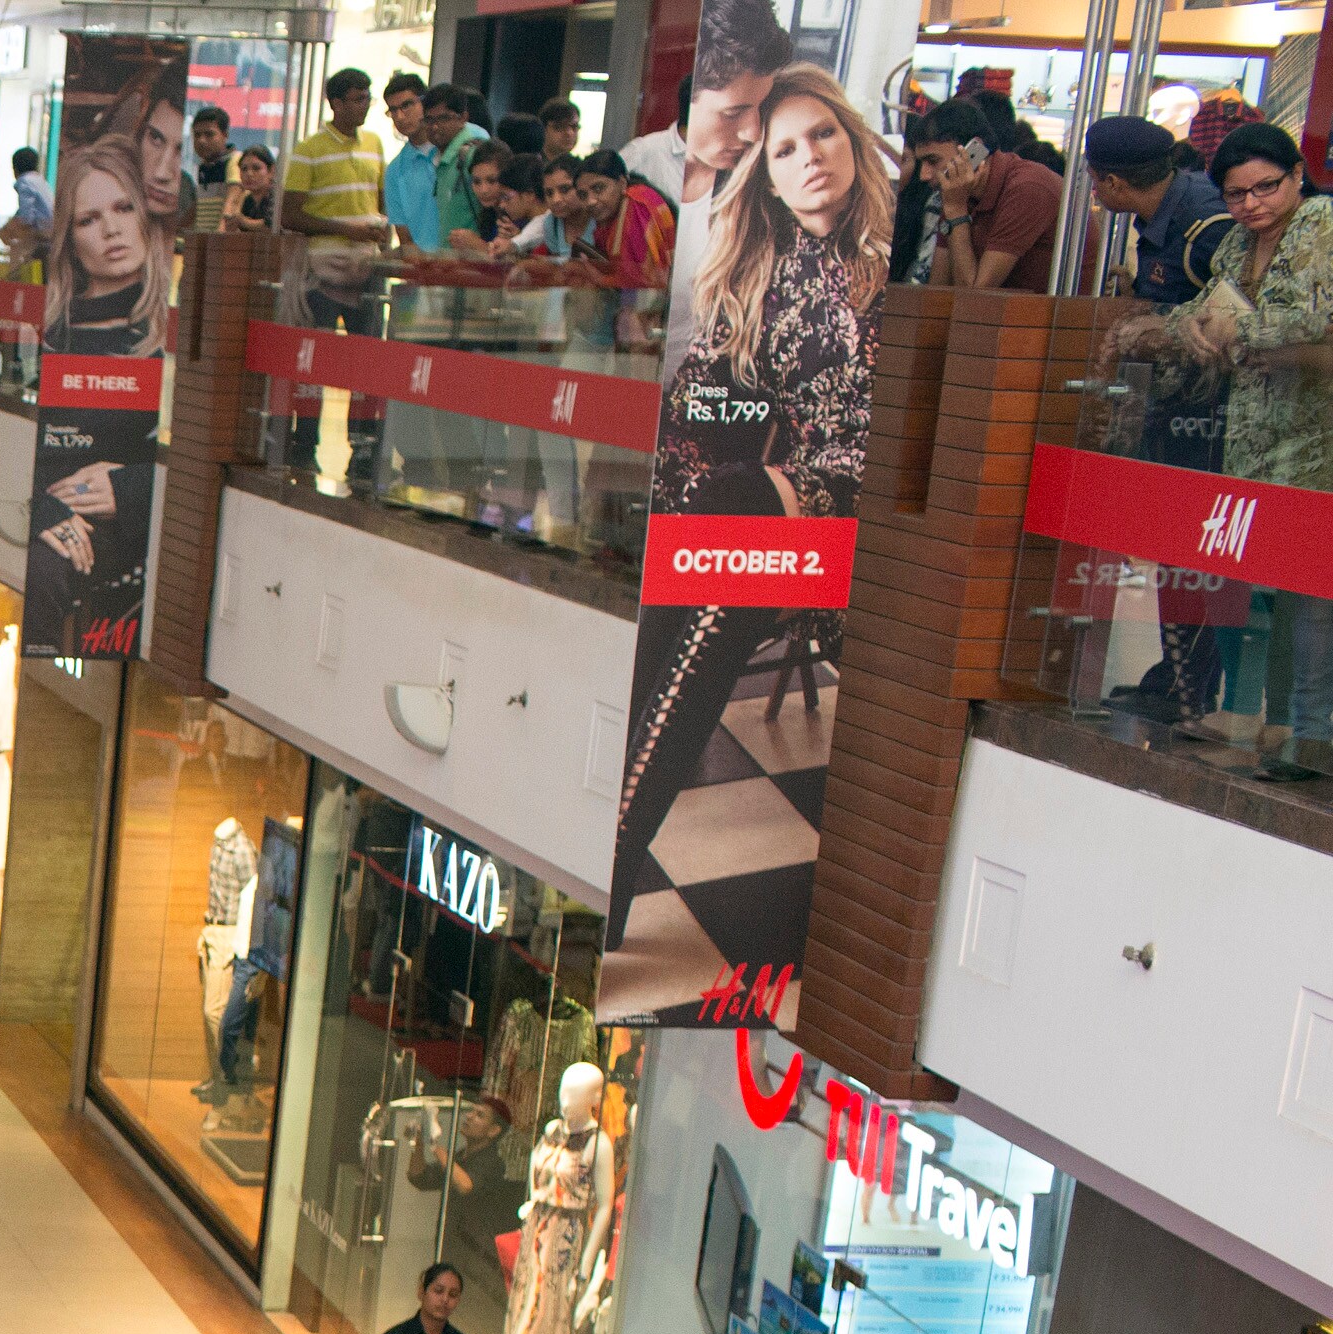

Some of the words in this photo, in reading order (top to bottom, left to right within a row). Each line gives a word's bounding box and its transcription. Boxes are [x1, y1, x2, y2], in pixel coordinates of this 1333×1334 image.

[61, 374, 83, 390] BE
[86, 375, 140, 392] THERE.
[689, 383, 729, 398] Dress
[1198, 493, 1258, 563] H&M
[673, 548, 799, 575] OCTOBER
[802, 551, 825, 575] 2.
[418, 826, 500, 934] KAZO
[697, 962, 795, 1024] H&M
[901, 1121, 1035, 1278] Travel
